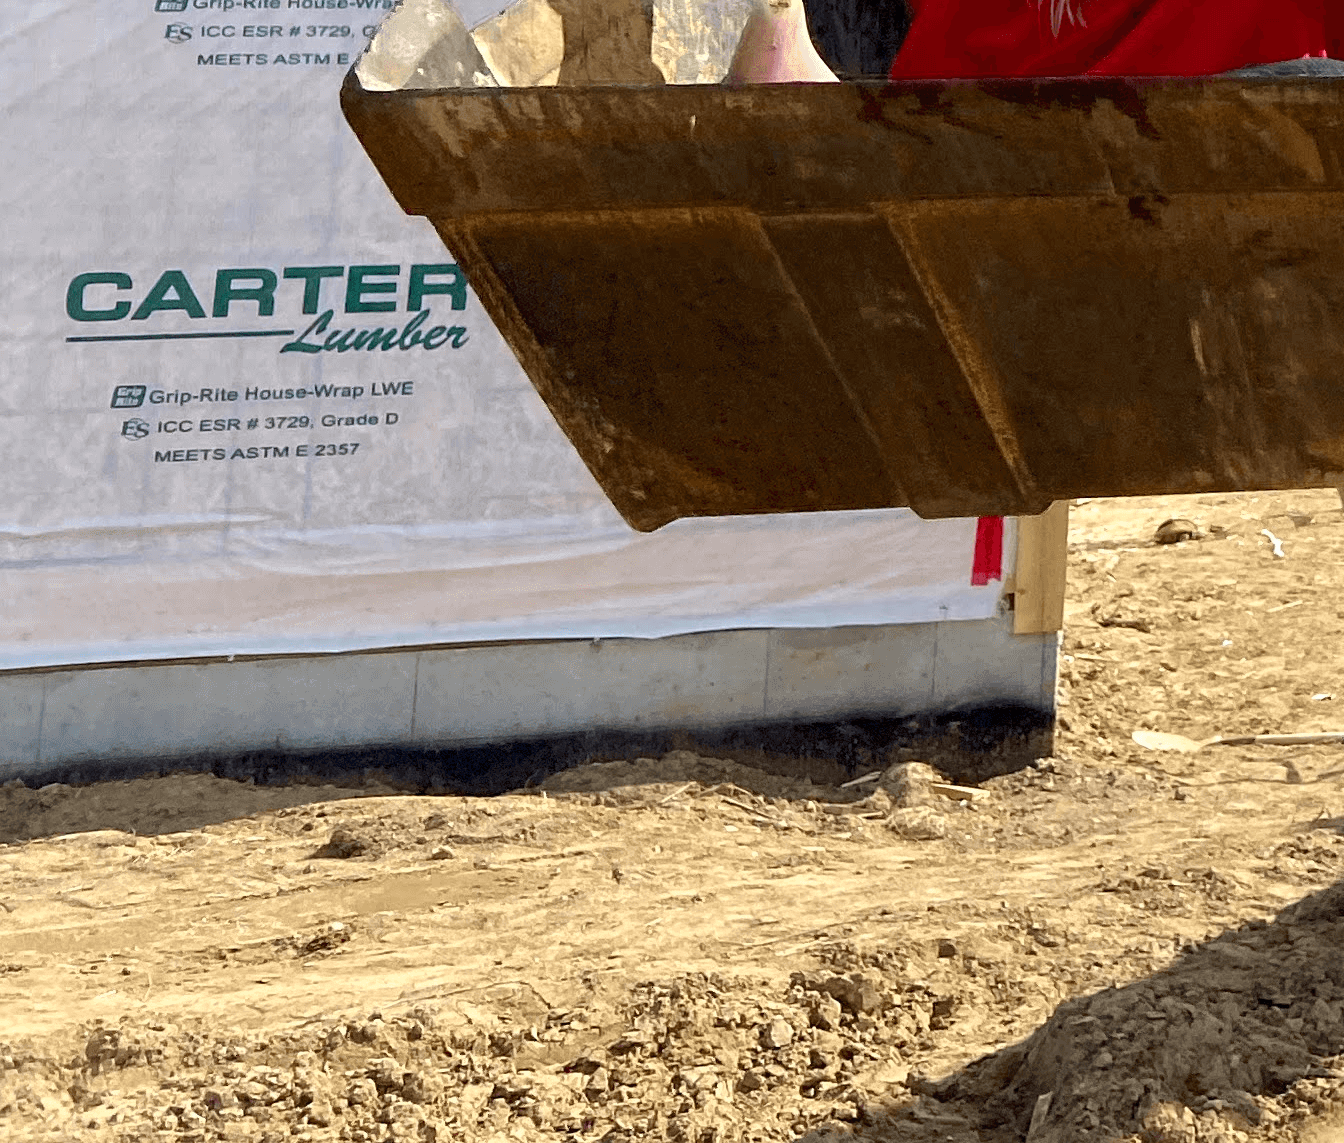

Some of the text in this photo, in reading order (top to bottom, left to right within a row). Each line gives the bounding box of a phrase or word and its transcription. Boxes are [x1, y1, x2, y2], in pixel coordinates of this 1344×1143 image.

[201, 26, 235, 37] ICC
[243, 26, 283, 37] ESR
[289, 26, 300, 37] #
[306, 25, 355, 38] 3729,
[198, 53, 348, 65] MEETS ASTM E
[65, 263, 469, 322] CARTER
[280, 309, 469, 354] Lumber
[149, 381, 413, 406] Grip-Rite House-Wrap LWE
[158, 420, 192, 433] ICC
[200, 419, 240, 431] ESR
[247, 418, 258, 430] #
[265, 416, 314, 429] 3729,
[322, 414, 378, 427] Grade
[386, 413, 398, 425] D
[155, 443, 359, 462] MEETS ASTM E 2357
